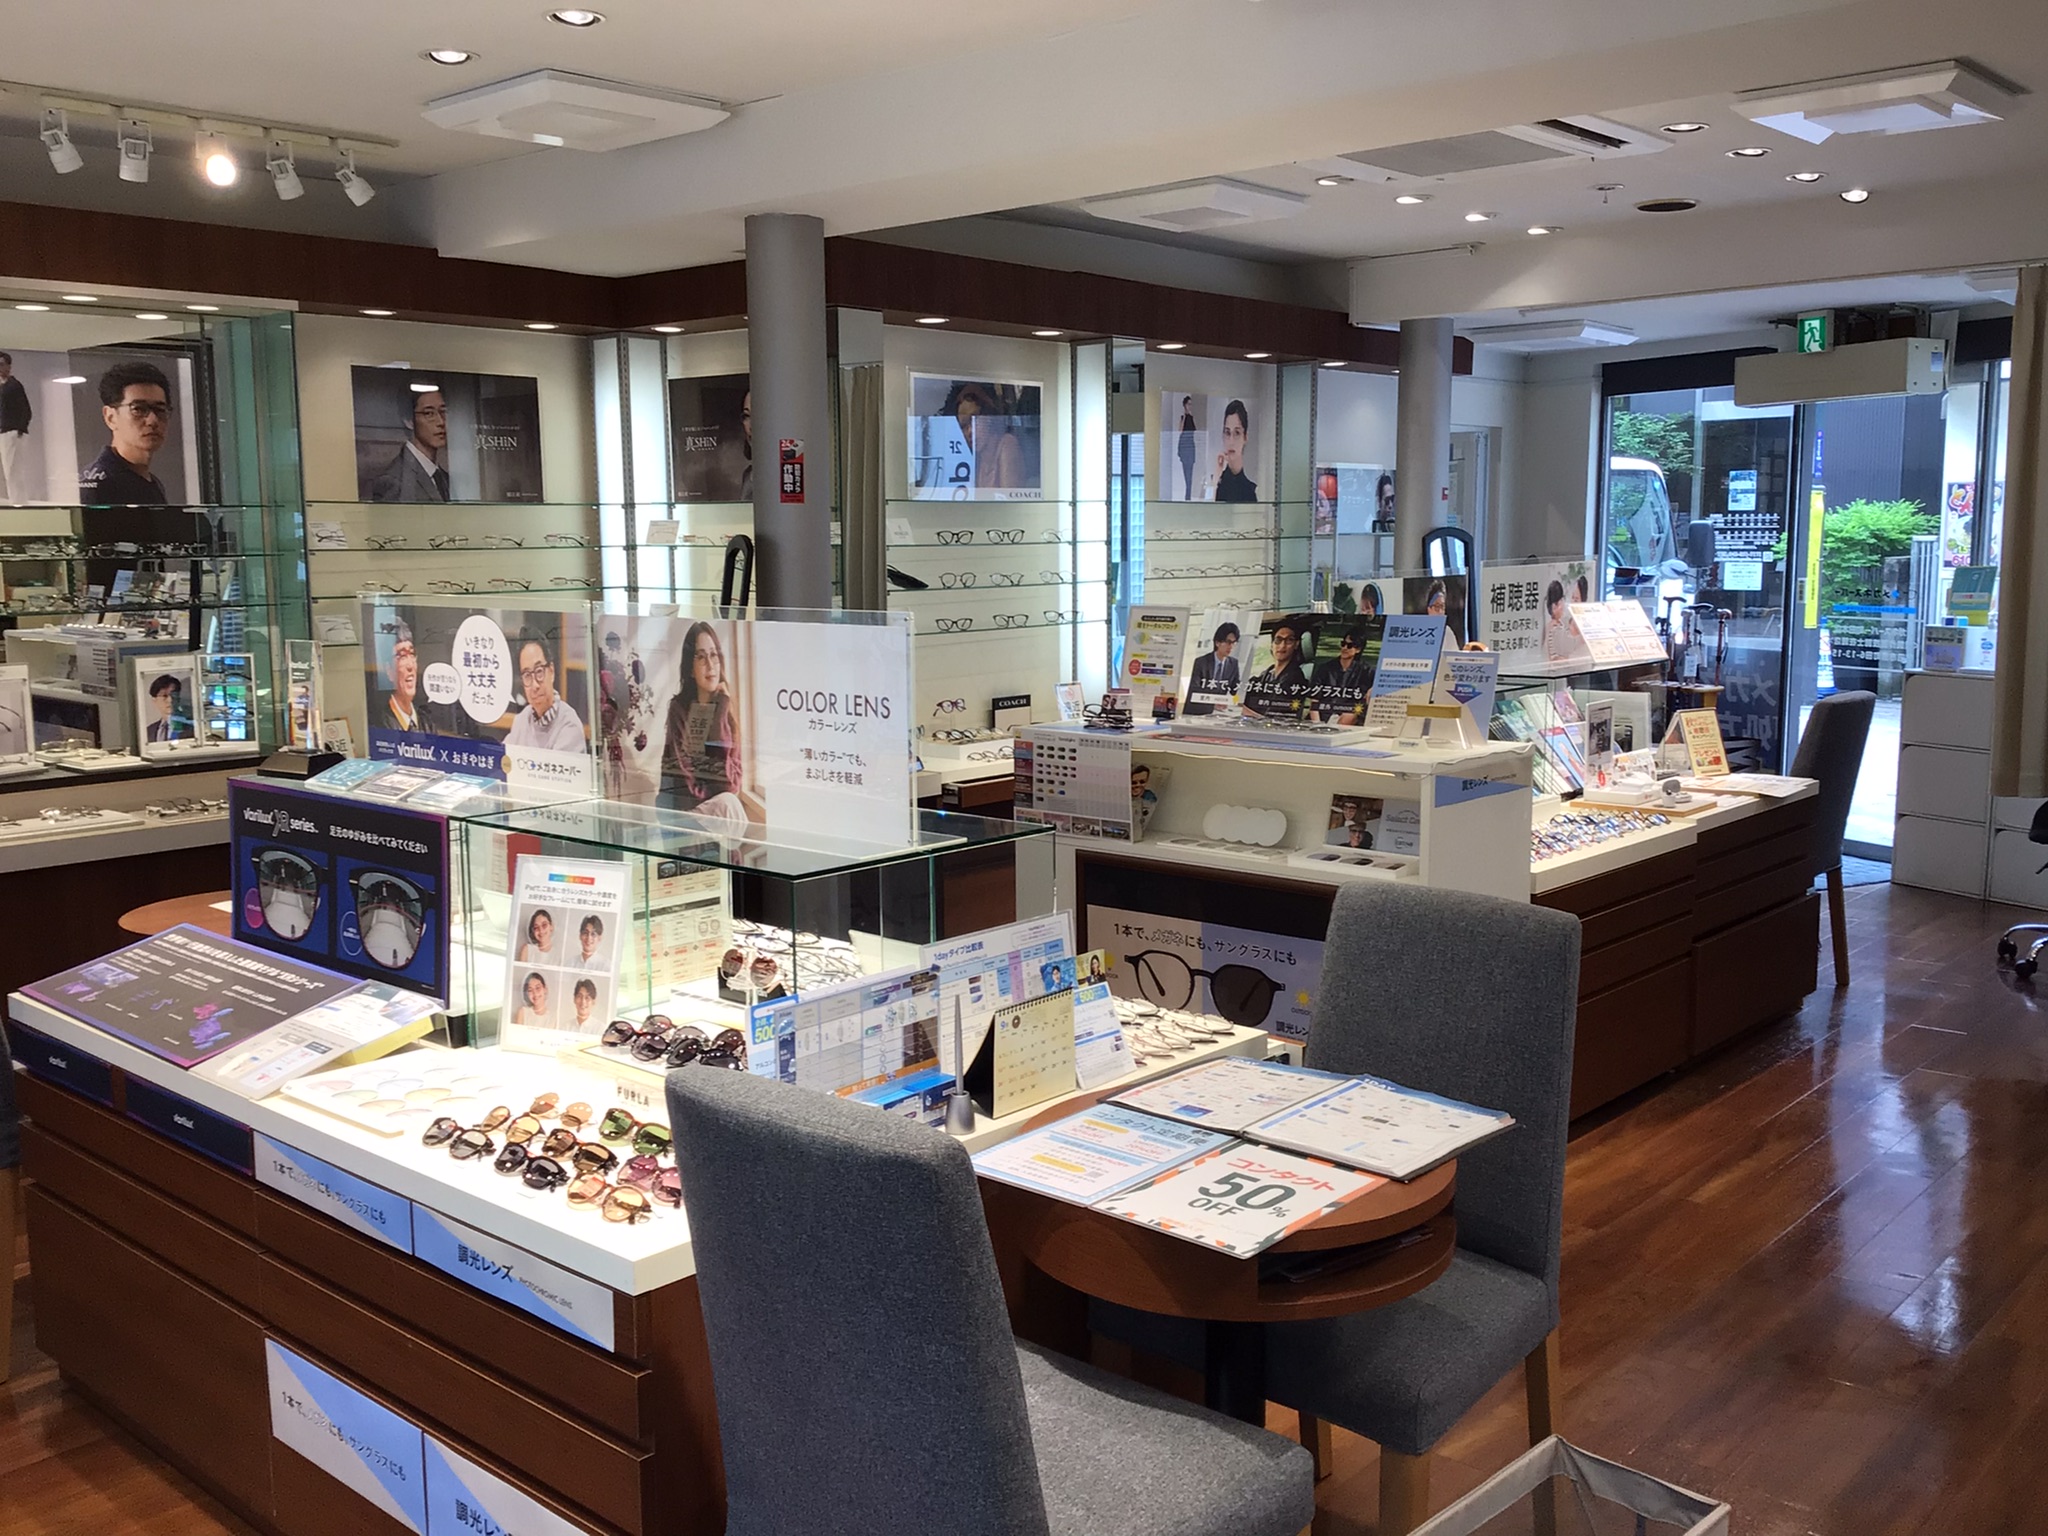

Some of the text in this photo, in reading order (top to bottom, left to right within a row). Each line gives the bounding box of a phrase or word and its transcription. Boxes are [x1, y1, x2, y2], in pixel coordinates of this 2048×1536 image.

[783, 464, 793, 493] 作動中
[1009, 491, 1041, 499] COACH
[1490, 582, 1539, 614] 補聴器
[1388, 626, 1438, 638] 調光レンズ
[465, 636, 495, 649] いきなり
[463, 652, 500, 670] 最初から
[467, 672, 496, 688] 大丈夫
[1444, 673, 1491, 683] 色が変わります
[1200, 678, 1363, 700] 1本で、メガネにも、サングラスにも
[472, 691, 494, 706] だった
[777, 688, 891, 719] COLOR LENS
[998, 699, 1027, 707] COACH
[808, 718, 858, 734] カラーレンズ
[452, 752, 495, 770] おぎやはぎ
[537, 763, 582, 776] メガネスーパー
[805, 768, 863, 786] まぶしさを軽減
[1114, 923, 1297, 966] 1本で、メガネにも、サングラスにも
[1276, 1020, 1310, 1036] 調光レン
[617, 1086, 650, 1107] FURLA
[1092, 1110, 1207, 1146] コンタクト定期便
[1226, 1158, 1335, 1192] コンタクト
[1187, 1197, 1245, 1217] OFF
[457, 1243, 514, 1283] 調光レンズ
